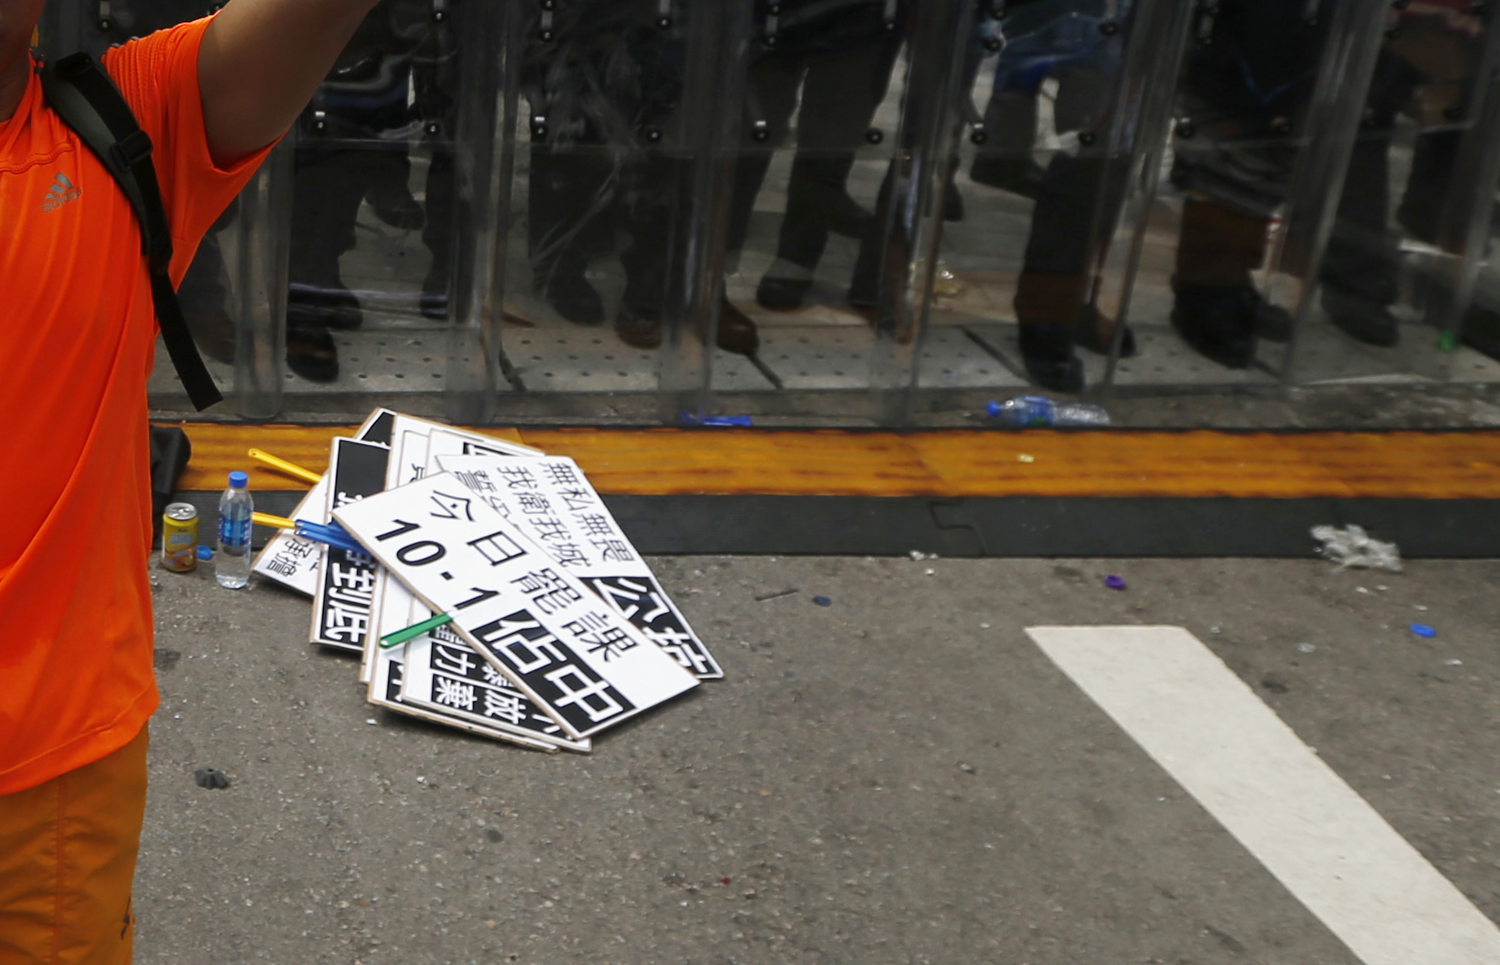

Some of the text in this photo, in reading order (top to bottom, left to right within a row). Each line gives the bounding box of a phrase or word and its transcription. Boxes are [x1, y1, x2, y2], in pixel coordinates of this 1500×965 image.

[496, 465, 592, 568] 我衛我城
[538, 461, 637, 564] 無私無畏
[428, 488, 640, 664] 今日罷課
[482, 614, 624, 723] 佔中
